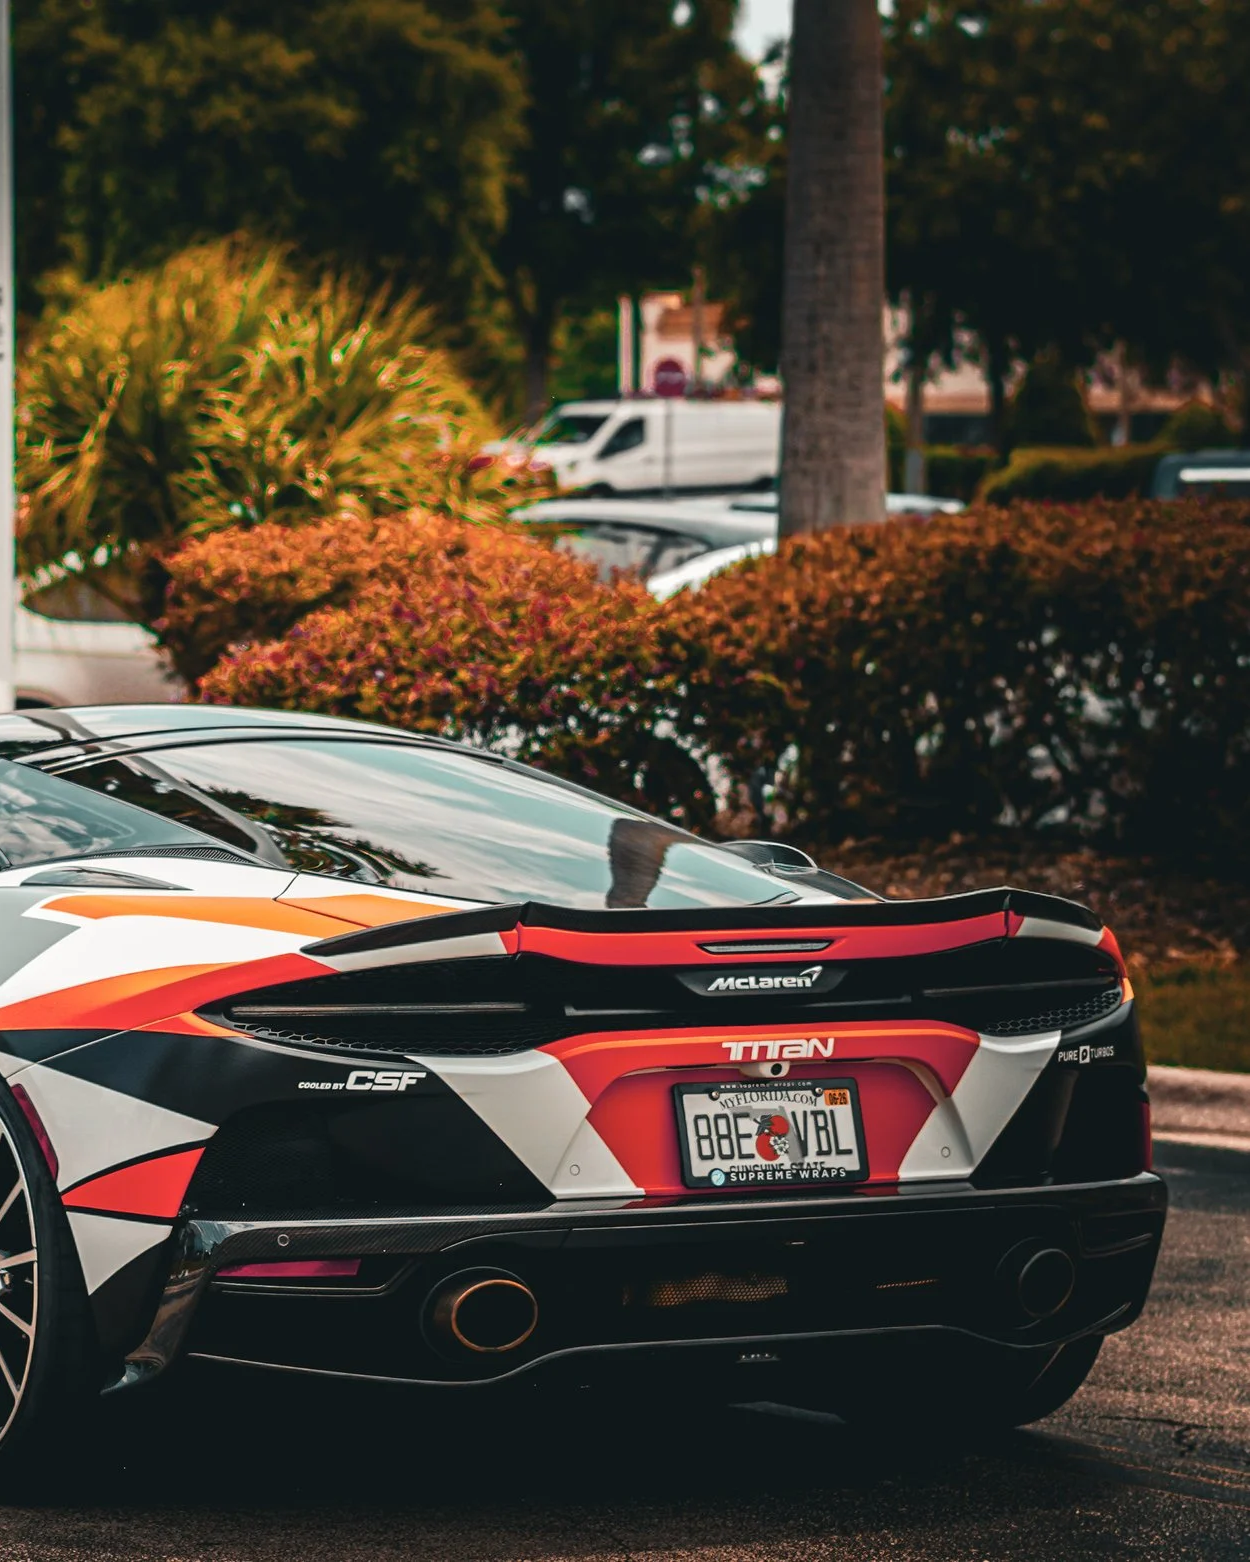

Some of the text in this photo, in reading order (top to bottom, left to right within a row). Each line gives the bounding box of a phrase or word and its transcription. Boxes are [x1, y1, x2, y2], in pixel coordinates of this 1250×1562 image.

[707, 975, 812, 991] McLaren
[721, 1037, 835, 1061] TITAN
[1058, 1050, 1078, 1062] PURE
[1090, 1046, 1114, 1059] TURBOS
[298, 1070, 427, 1091] COOLED BY CSF
[719, 1090, 818, 1111] MYFLORIDA.COM
[693, 1108, 853, 1161] 88E VBL
[730, 1167, 846, 1182] SUPREME WRAPS
